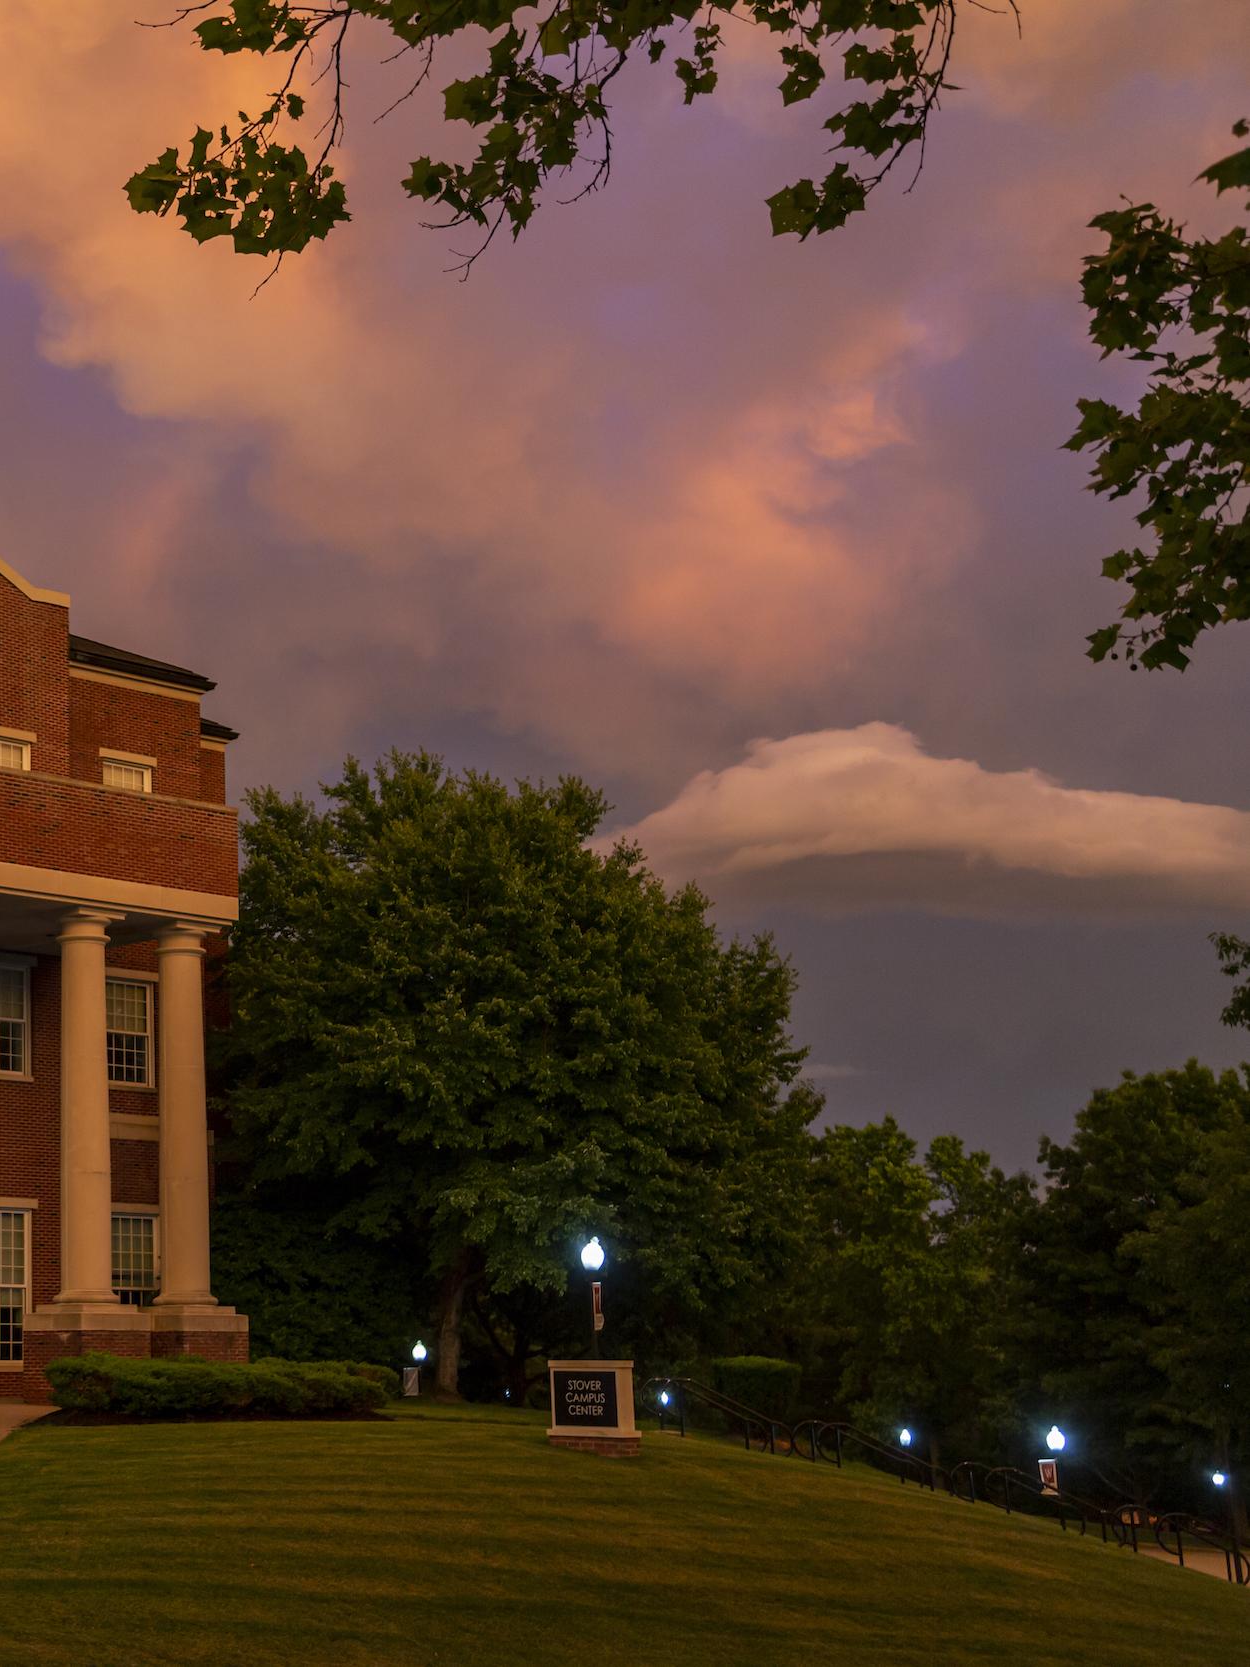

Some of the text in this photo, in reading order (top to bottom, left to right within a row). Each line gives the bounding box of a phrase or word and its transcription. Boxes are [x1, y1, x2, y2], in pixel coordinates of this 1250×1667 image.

[568, 1380, 602, 1391] STOVER
[565, 1392, 606, 1404] CAMPUS
[568, 1404, 604, 1416] CENTER
